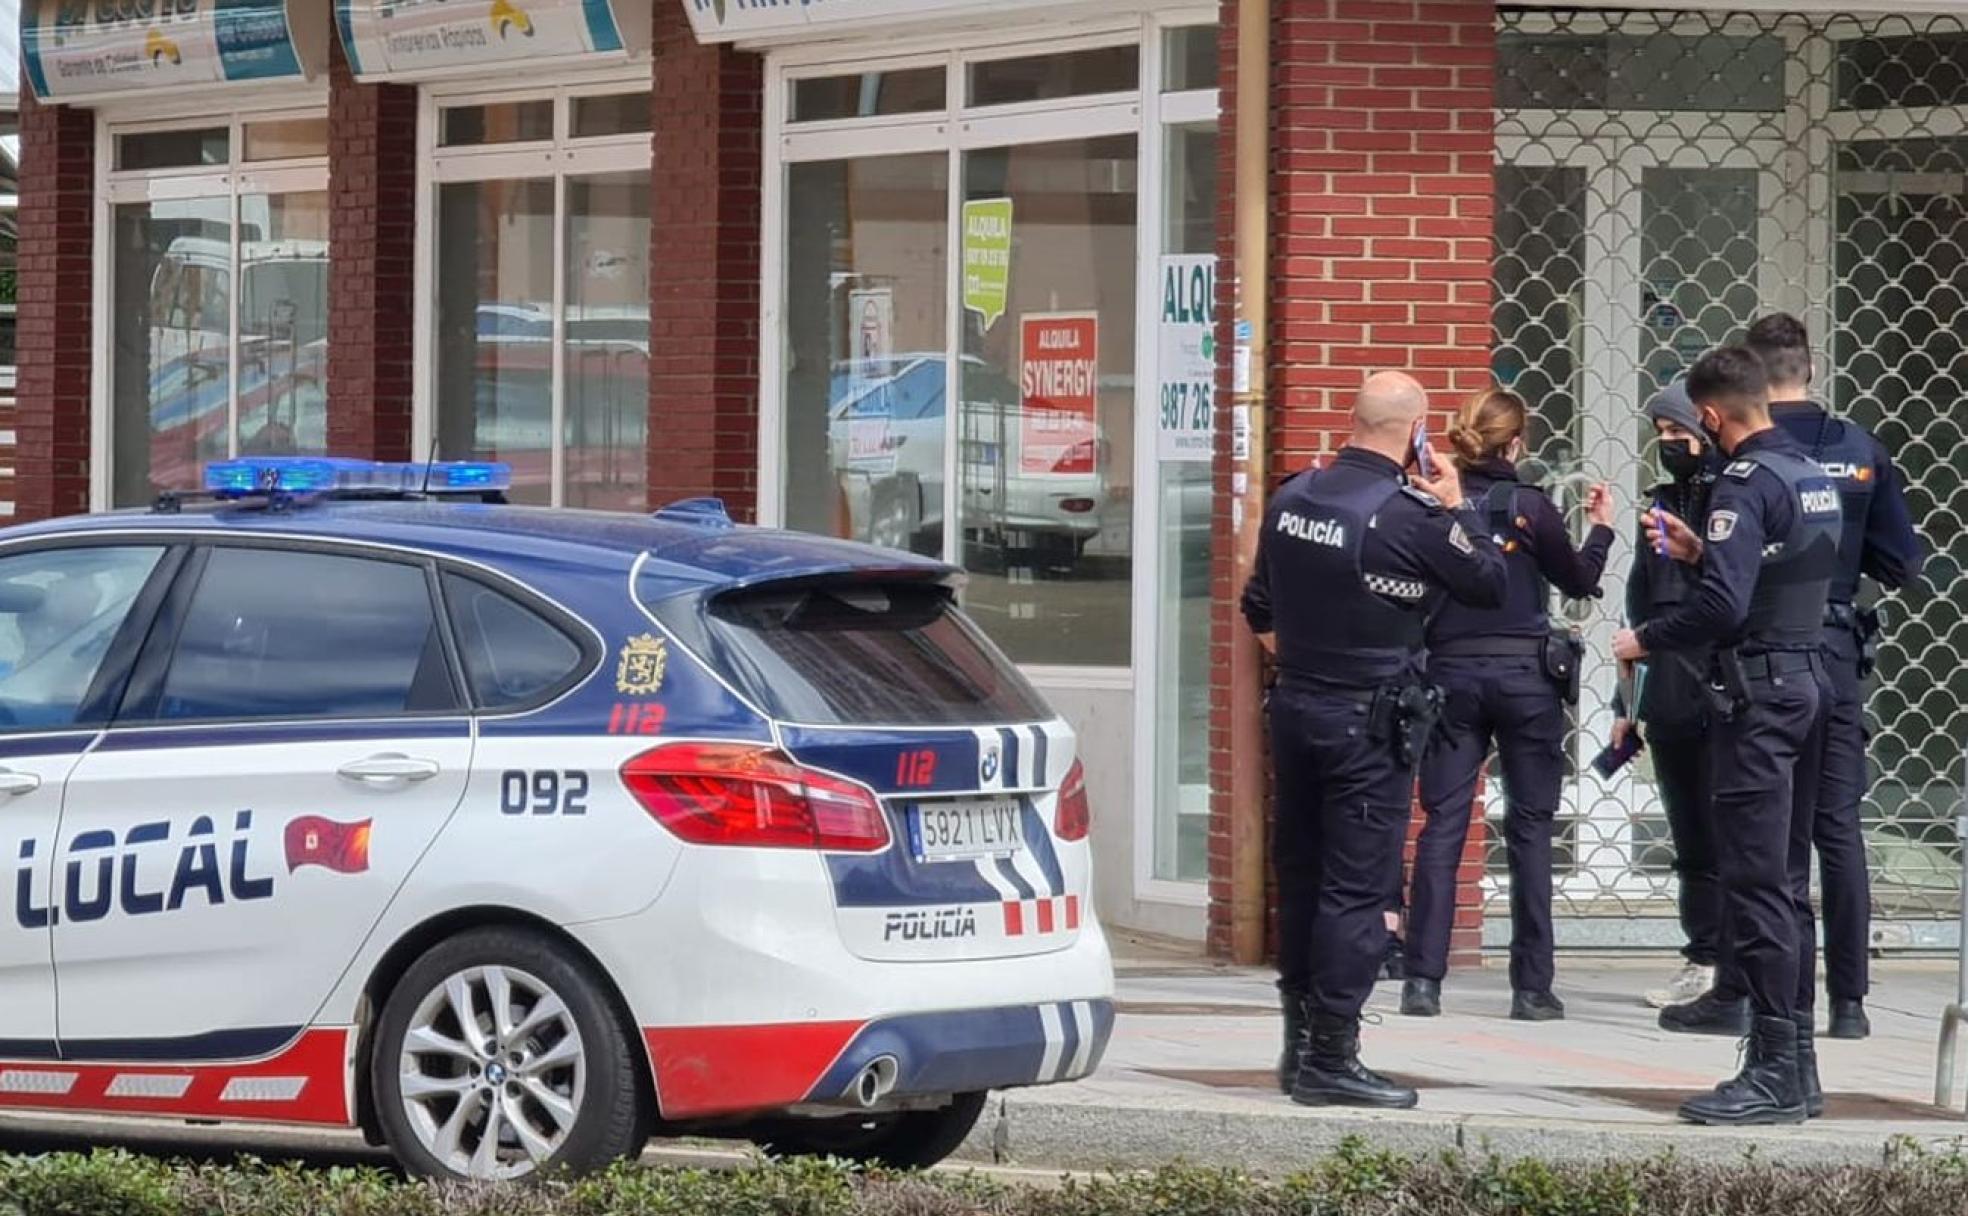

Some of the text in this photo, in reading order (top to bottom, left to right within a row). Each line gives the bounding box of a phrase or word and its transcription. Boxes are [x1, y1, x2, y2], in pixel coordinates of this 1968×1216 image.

[967, 214, 1006, 241] ALQUILA
[1038, 327, 1080, 349] ALQUILA
[1023, 359, 1095, 398] SYNERGY
[1160, 382, 1210, 430] 987 26
[1277, 511, 1344, 549] POLICÍA
[607, 702, 667, 734] 112
[896, 750, 937, 786] 112
[500, 769, 588, 815] 092
[924, 808, 974, 847] 5921
[980, 807, 1018, 843] LVX
[15, 808, 274, 929] LOCAL
